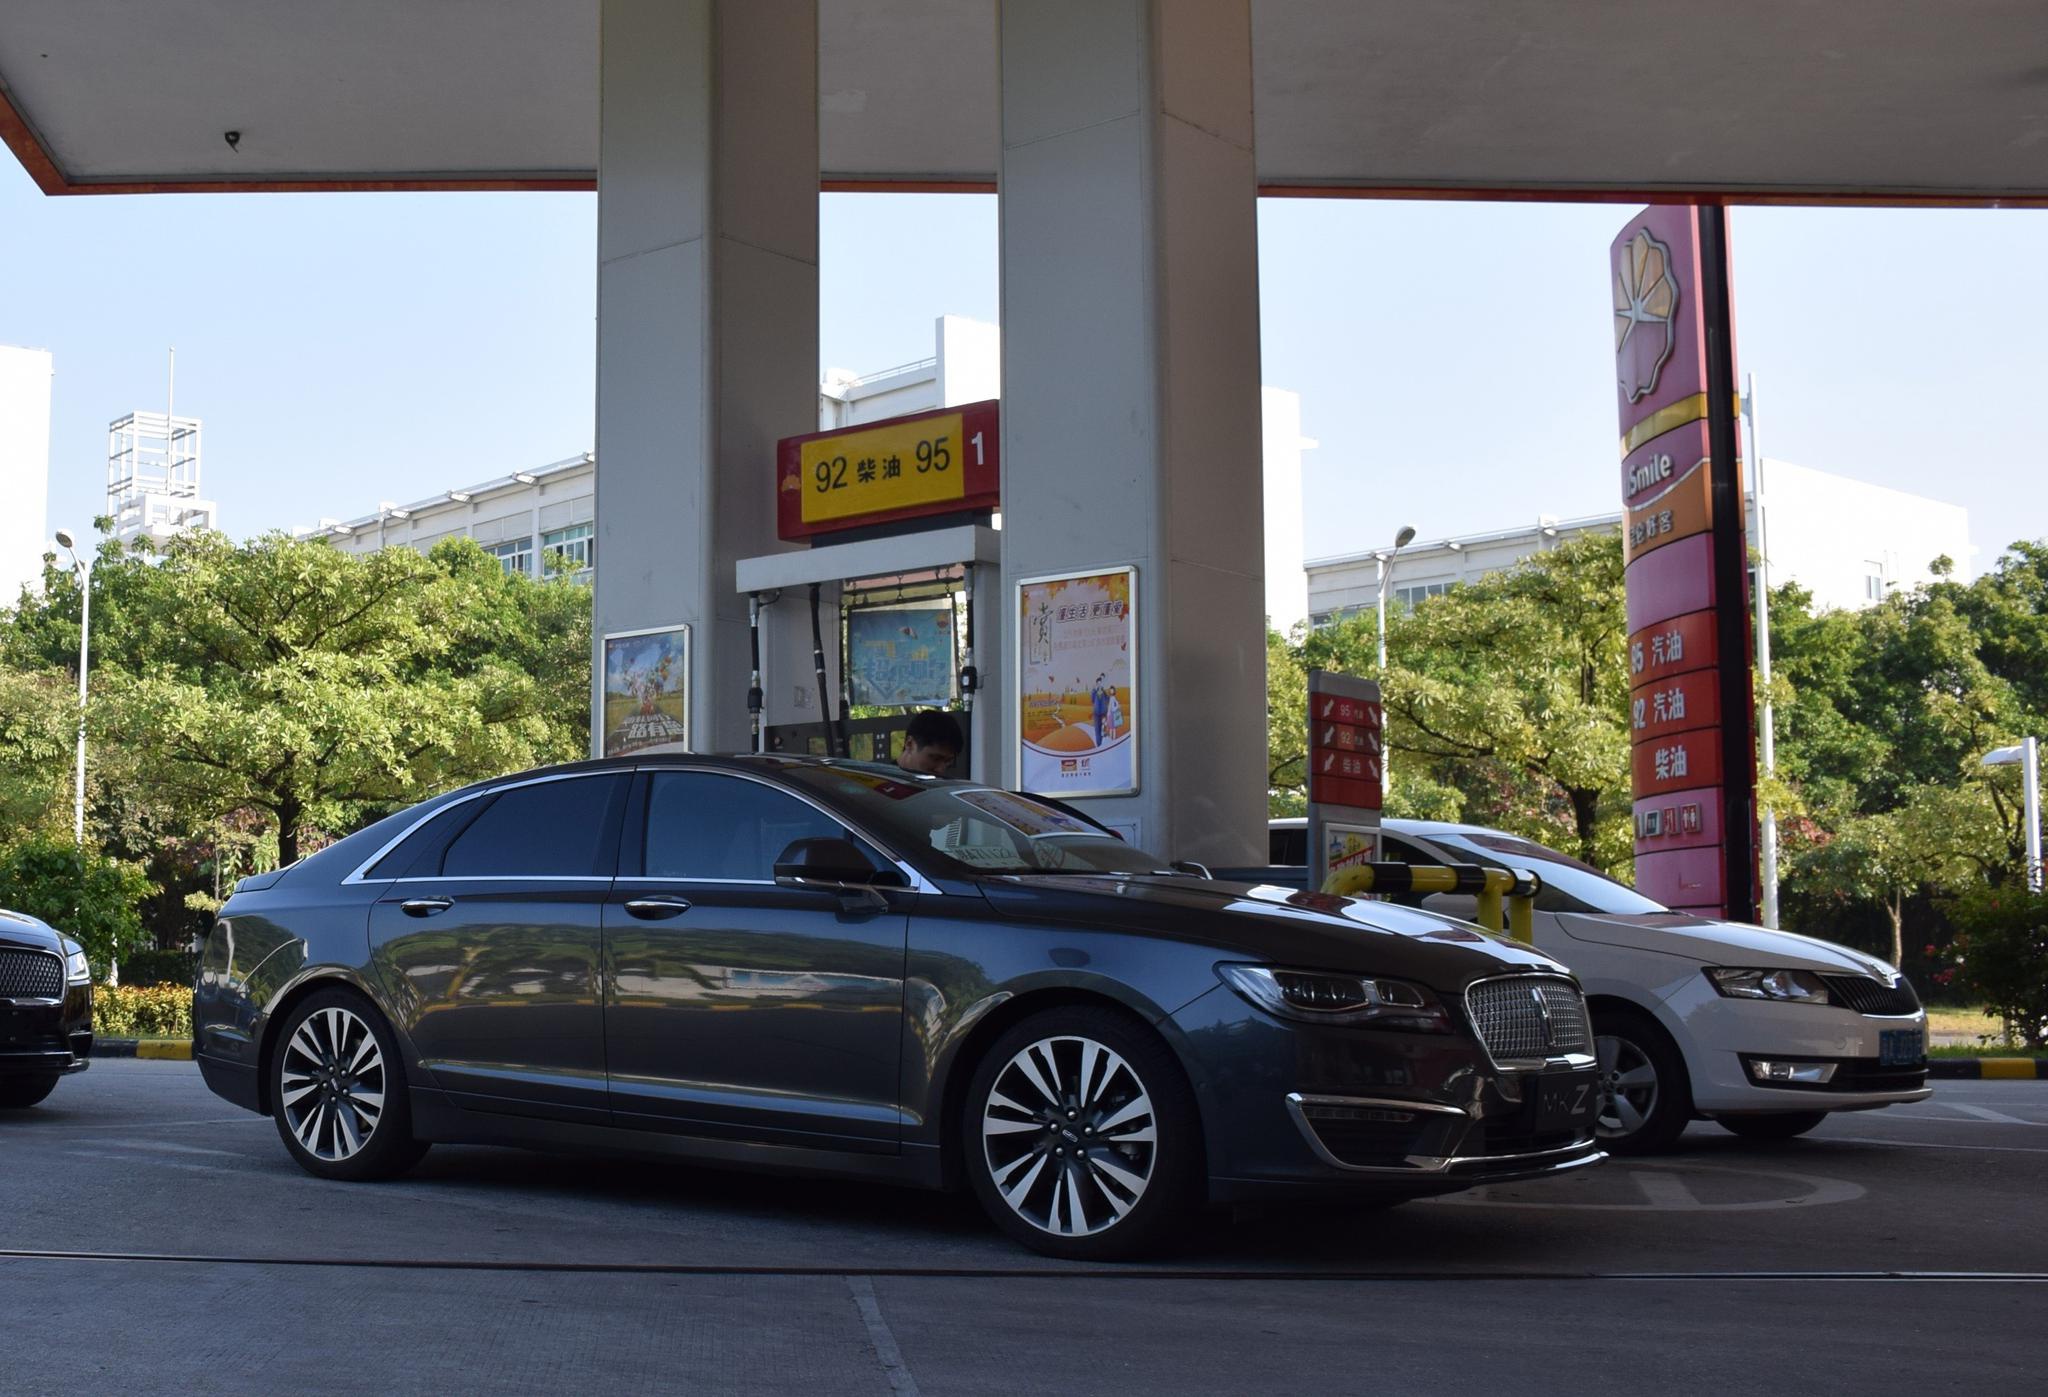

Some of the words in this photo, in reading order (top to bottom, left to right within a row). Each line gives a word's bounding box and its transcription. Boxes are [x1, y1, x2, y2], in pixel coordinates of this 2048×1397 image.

[815, 456, 848, 493] 92
[857, 454, 901, 483] 柴油
[916, 436, 950, 473] 95
[971, 432, 984, 465] 1
[1627, 454, 1672, 498] Smile
[1631, 642, 1644, 674] 95
[1652, 629, 1683, 667] 汽油
[1633, 698, 1646, 729] 92
[1653, 688, 1685, 723] 汽油
[1655, 745, 1688, 780] 柴油
